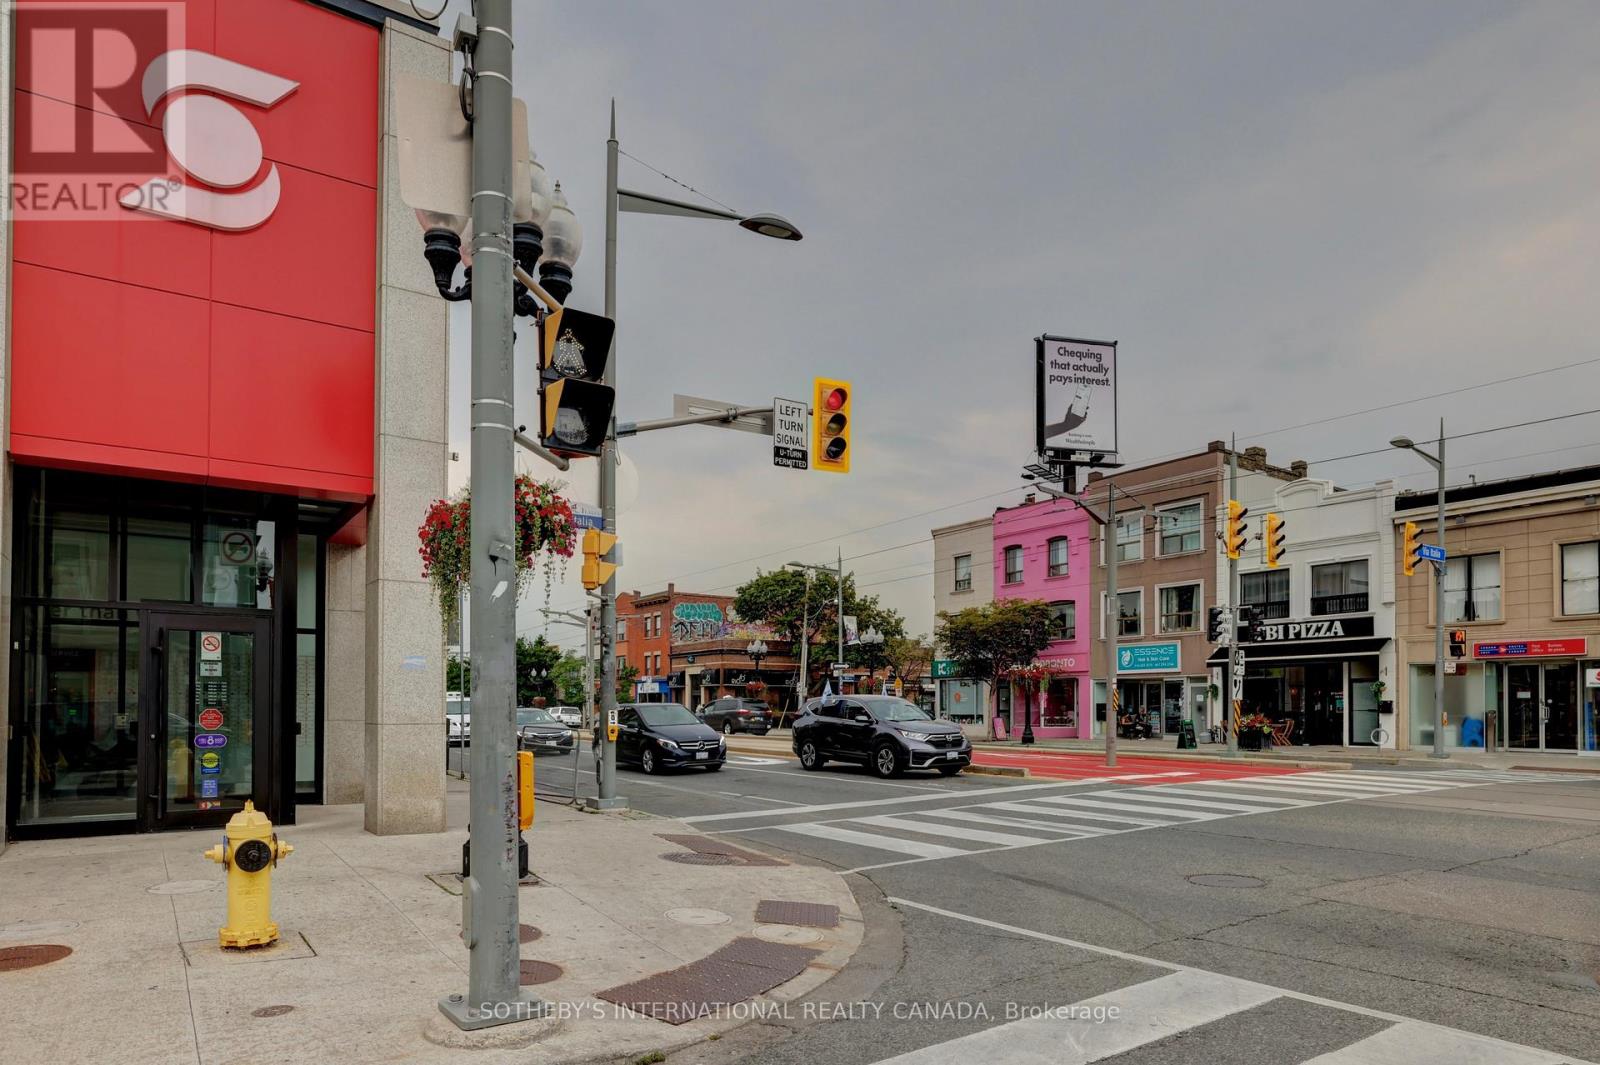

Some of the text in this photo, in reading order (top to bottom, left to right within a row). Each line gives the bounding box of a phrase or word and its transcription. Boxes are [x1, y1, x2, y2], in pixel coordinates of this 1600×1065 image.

[1057, 346, 1102, 362] Chequing
[1050, 359, 1109, 376] that actually
[1049, 373, 1111, 386] pays interest.
[779, 405, 802, 418] LEFT
[778, 418, 804, 432] TURN
[776, 433, 805, 447] SIGNAL
[779, 448, 802, 459] U-TURN
[774, 456, 807, 469] PERMITTED
[1288, 621, 1344, 640] PIZZA
[1134, 646, 1176, 656] ESSENCE
